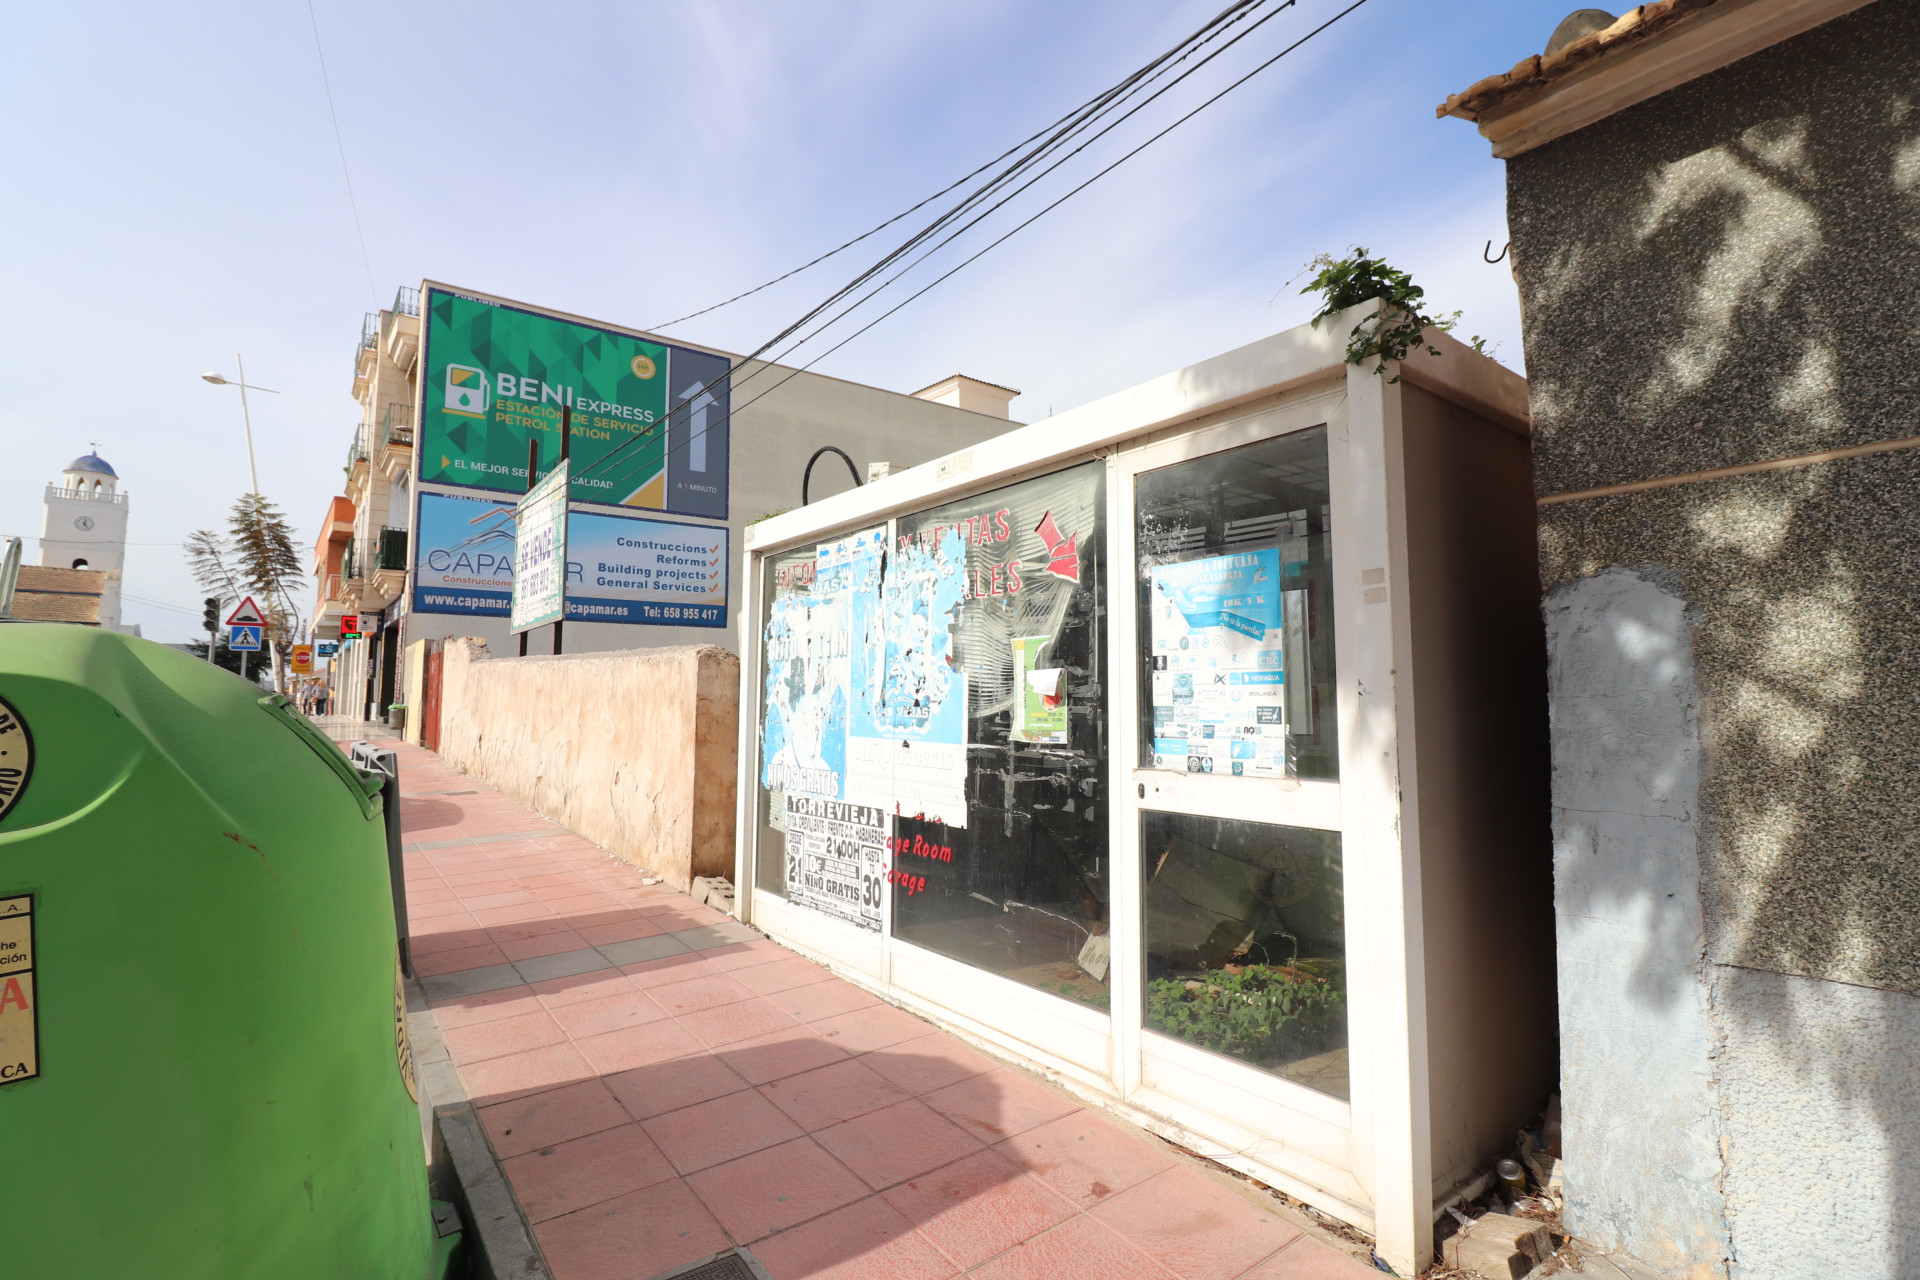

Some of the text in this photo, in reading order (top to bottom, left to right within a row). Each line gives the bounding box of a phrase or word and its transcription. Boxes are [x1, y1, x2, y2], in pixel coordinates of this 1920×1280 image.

[496, 372, 654, 423] BENI EXPRESS
[495, 412, 611, 441] PETROL SATION
[496, 399, 654, 436] ESTACIÓN DE SERVICIO
[454, 459, 468, 469] EL
[470, 463, 509, 476] MEJOR
[571, 477, 613, 489] CALIDAD
[689, 484, 718, 494] MINUTO
[520, 526, 552, 573] SE VENDE
[616, 537, 707, 554] Construccions
[776, 560, 817, 588] INFO
[919, 507, 1011, 554] VETAS
[656, 554, 707, 567] Reforms
[1212, 553, 1259, 571] NOCTURNA
[598, 563, 707, 580] Building projects
[967, 559, 1023, 600] LES
[442, 575, 513, 587] Construccione
[597, 576, 706, 593] General Services
[424, 594, 513, 610] www.capamar.
[565, 601, 628, 618] @capamar.es
[643, 606, 718, 620] Tel: 658 955 417
[799, 766, 840, 797] GRATIS
[791, 794, 880, 828] TORREVIEJA
[828, 821, 845, 837] FRENTE
[855, 826, 884, 846] HABANERAS
[864, 846, 880, 863] HASTA
[884, 834, 952, 863] age Room
[869, 863, 875, 875] TO
[826, 878, 860, 902] GRATIS
[862, 873, 881, 910] 30
[0, 941, 17, 950] he
[0, 953, 27, 965] ción
[0, 977, 30, 1014] A
[0, 1062, 29, 1080] CA
